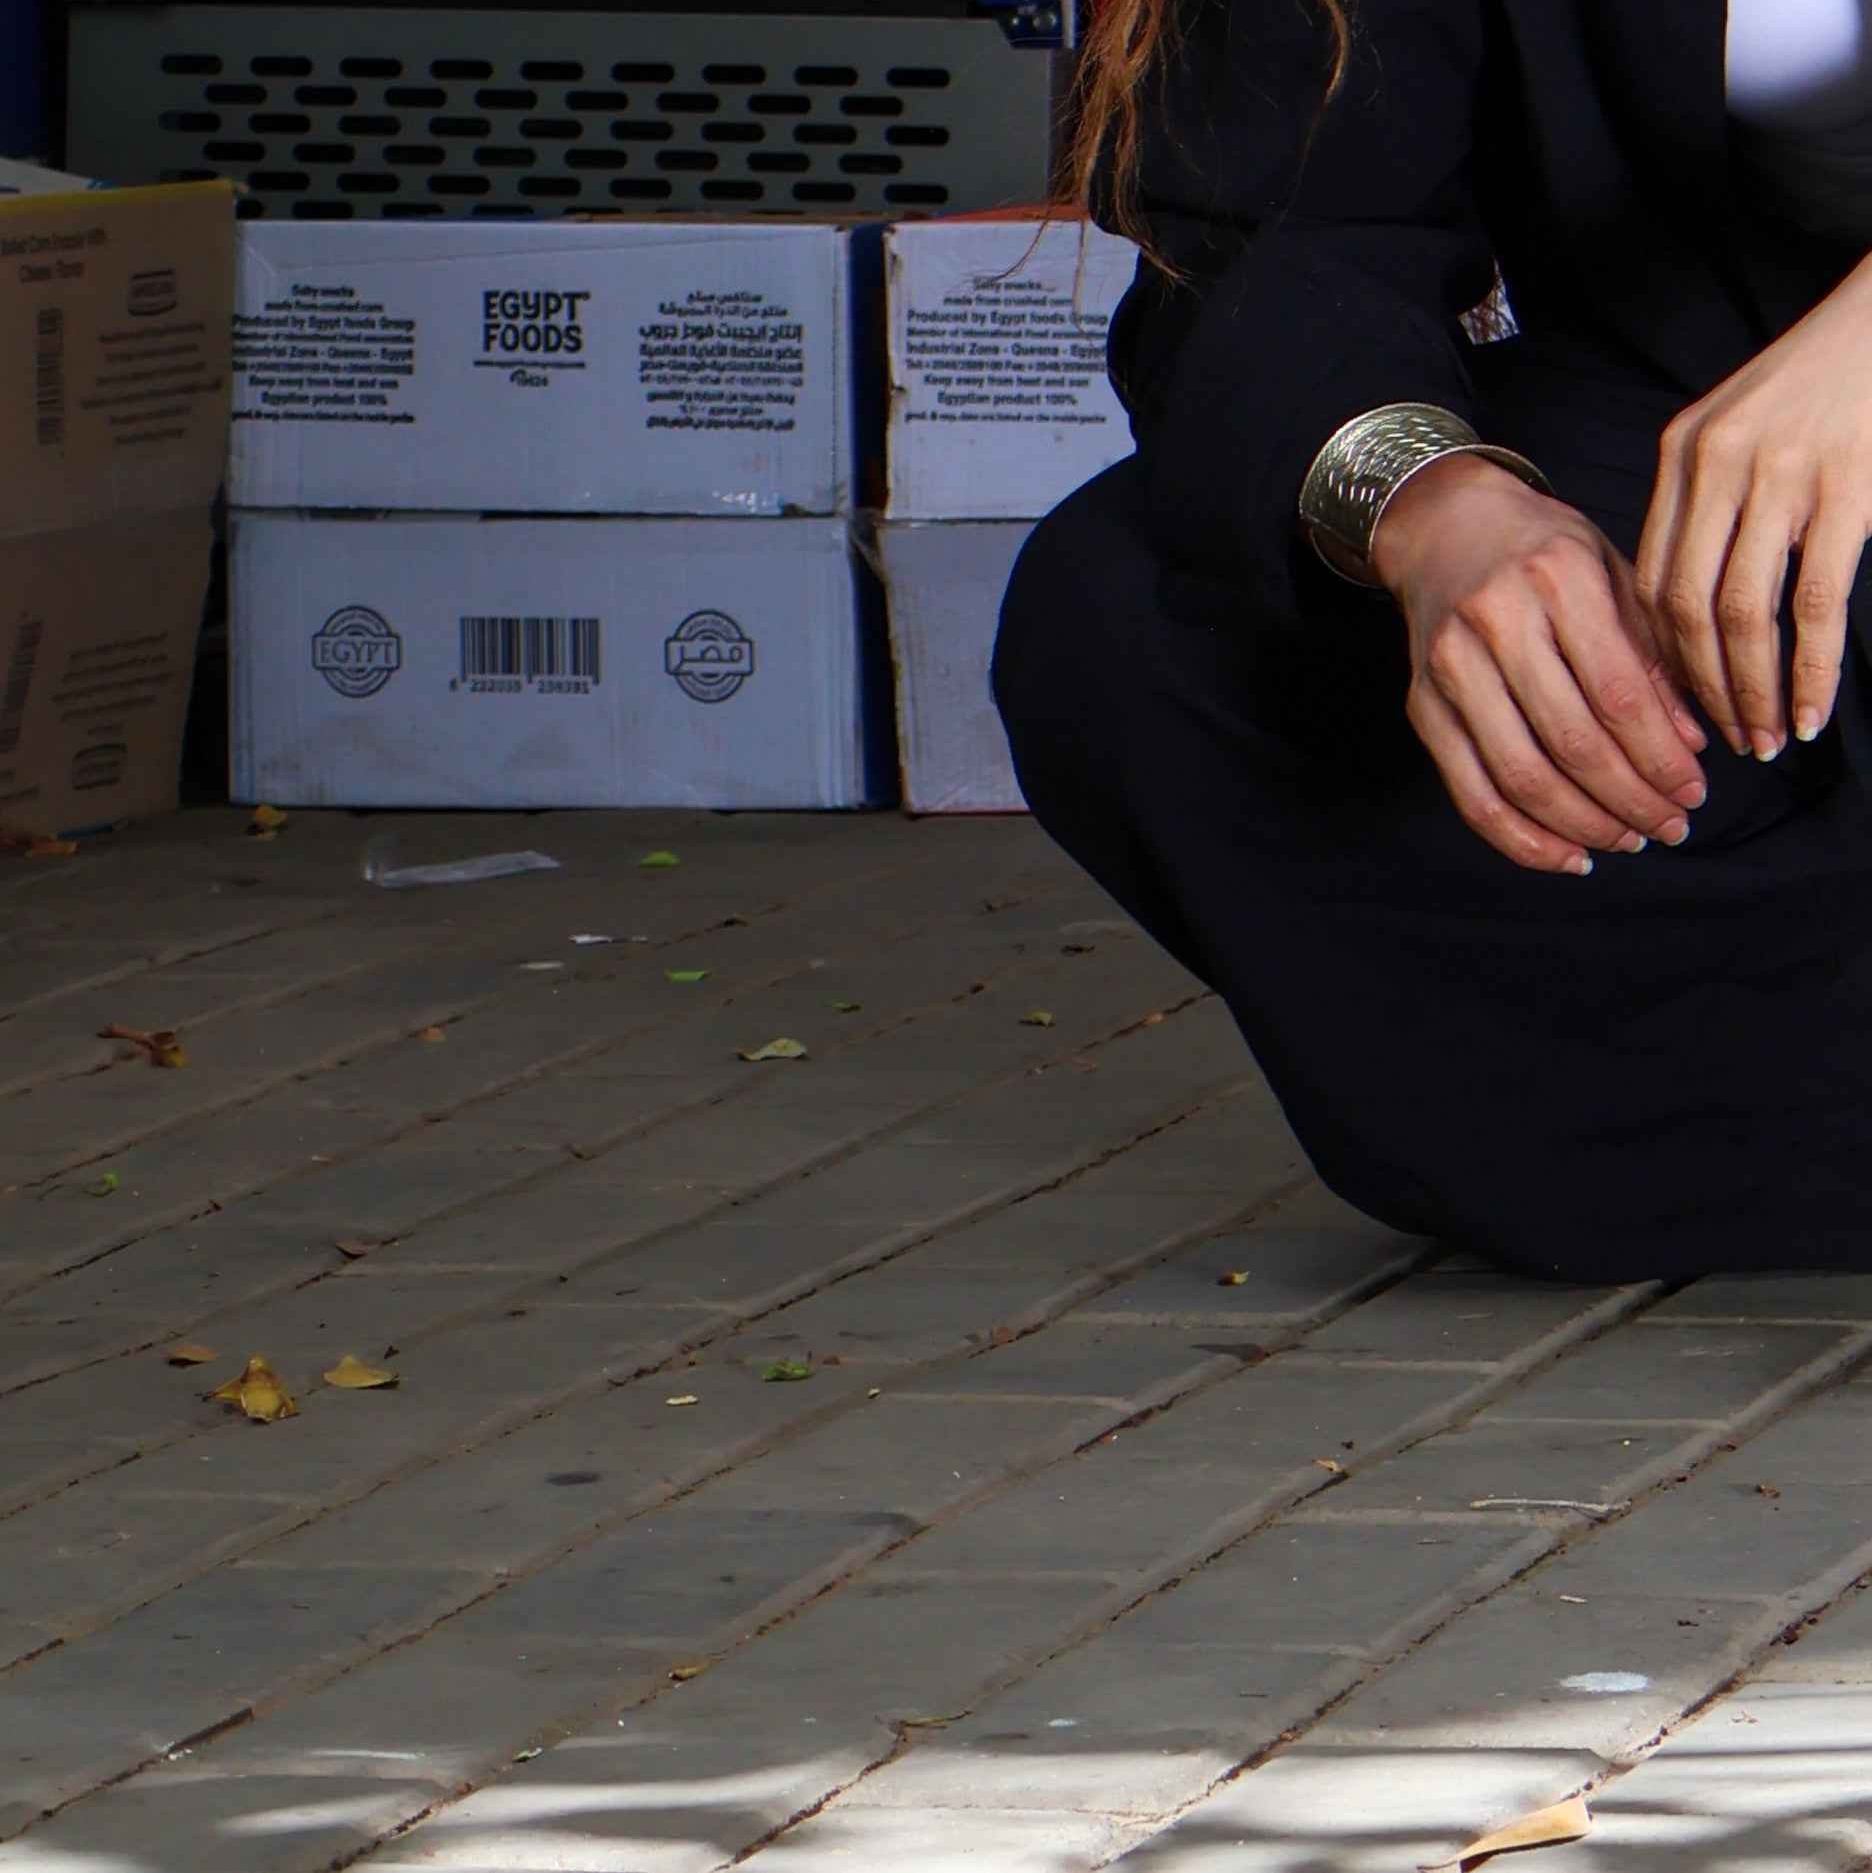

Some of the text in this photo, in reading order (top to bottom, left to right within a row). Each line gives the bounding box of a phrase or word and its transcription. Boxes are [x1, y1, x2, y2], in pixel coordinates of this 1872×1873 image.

[482, 291, 581, 321] EGYPT
[907, 310, 1065, 325] Produced Egypt foods
[482, 324, 583, 353] FOODS
[969, 344, 999, 354] Zone
[993, 393, 1041, 405] product
[318, 635, 395, 667] EGYPT
